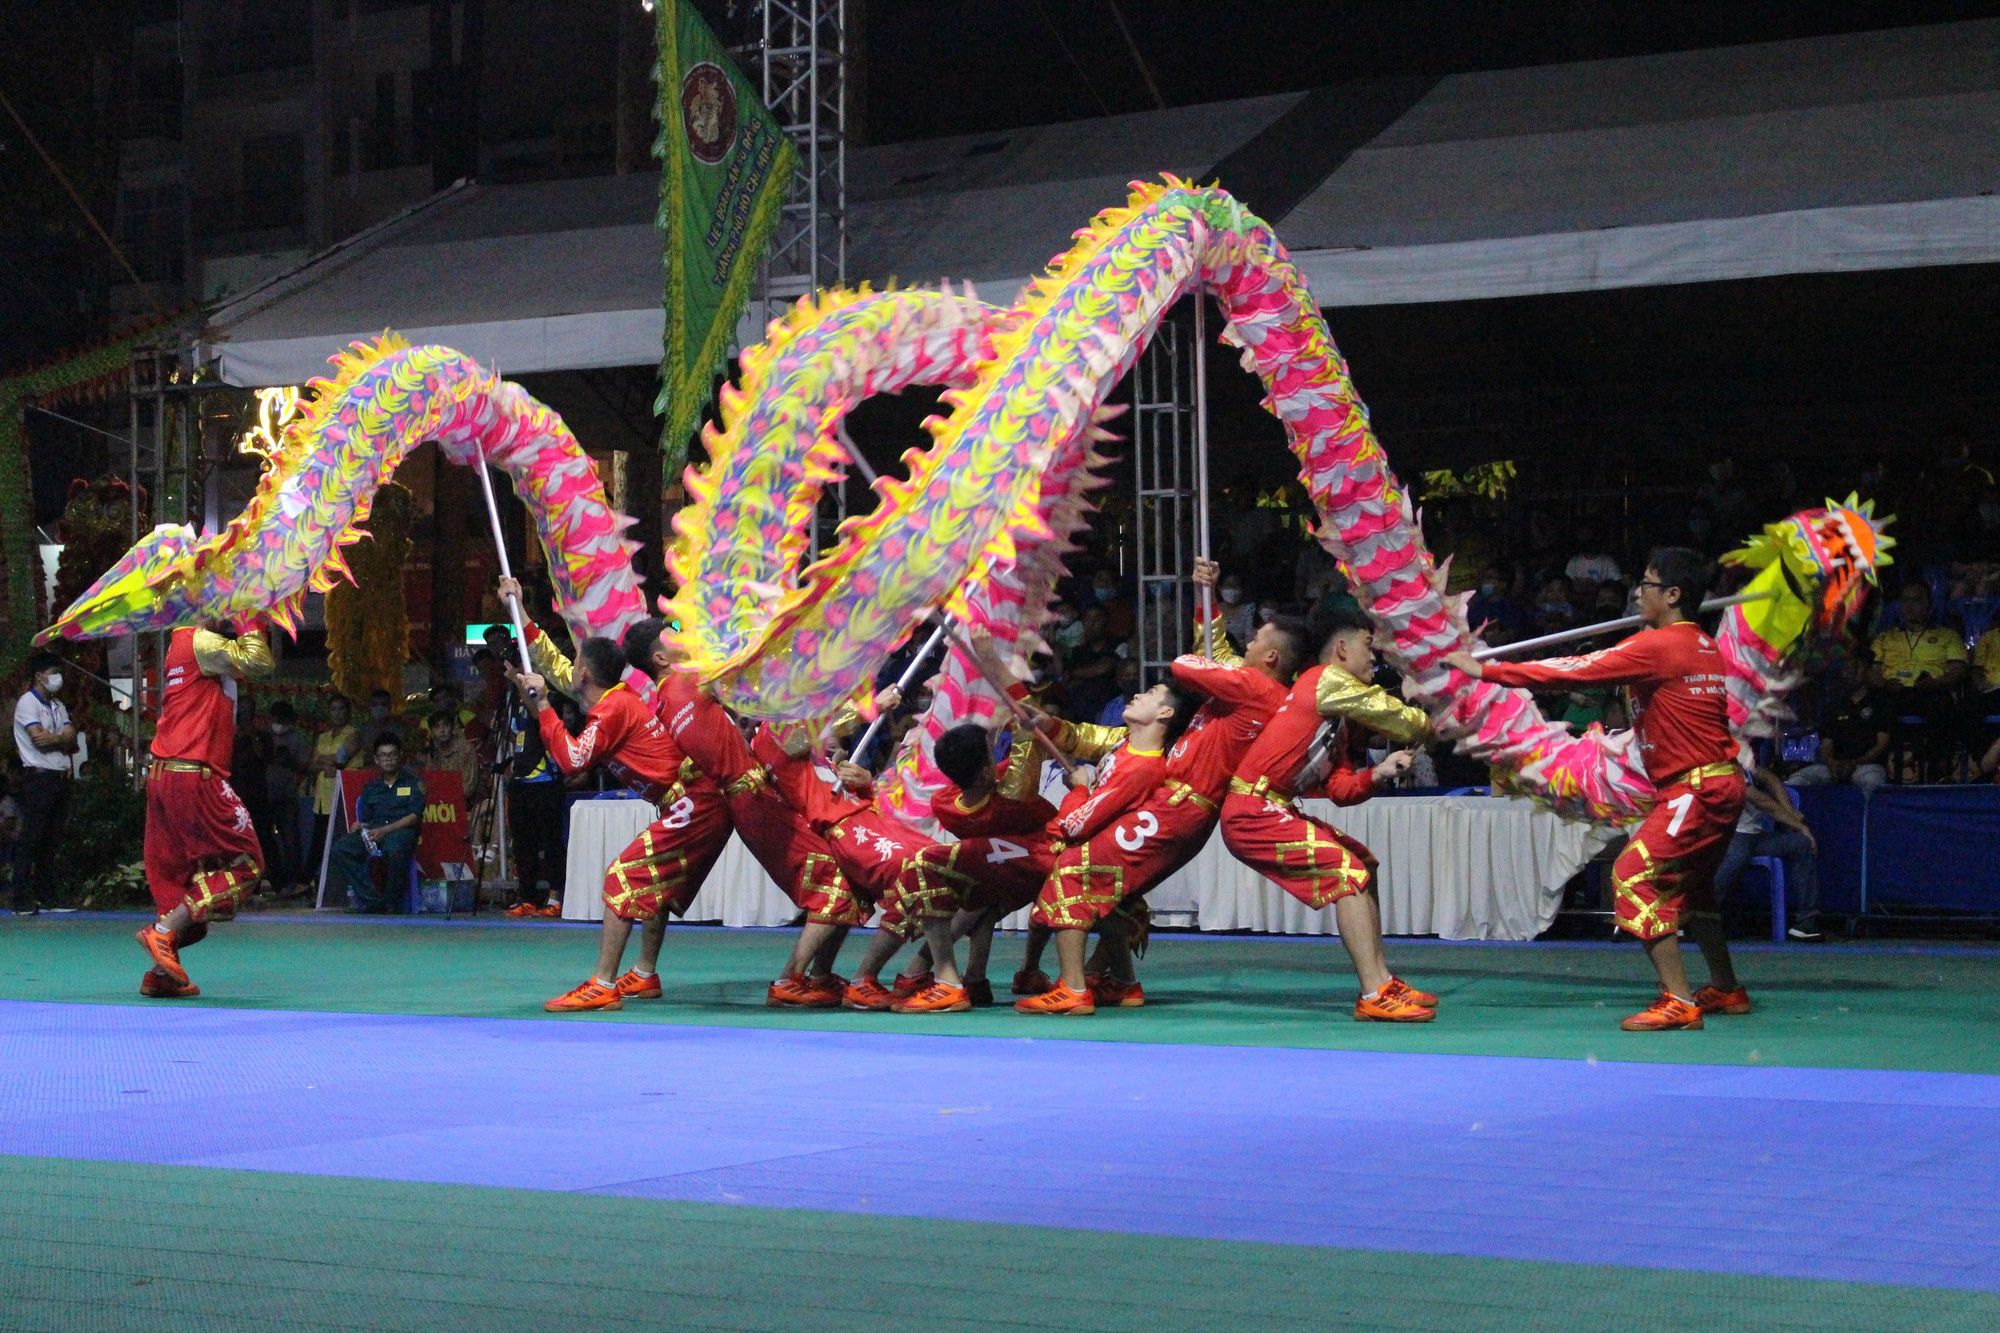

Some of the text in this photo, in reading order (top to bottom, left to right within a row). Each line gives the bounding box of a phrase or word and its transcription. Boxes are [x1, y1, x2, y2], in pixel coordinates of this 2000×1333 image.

[422, 800, 456, 822] MỜI
[662, 796, 695, 829] 8
[1666, 793, 1694, 837] 1
[1114, 810, 1159, 851] 3
[986, 837, 1029, 865] 4
